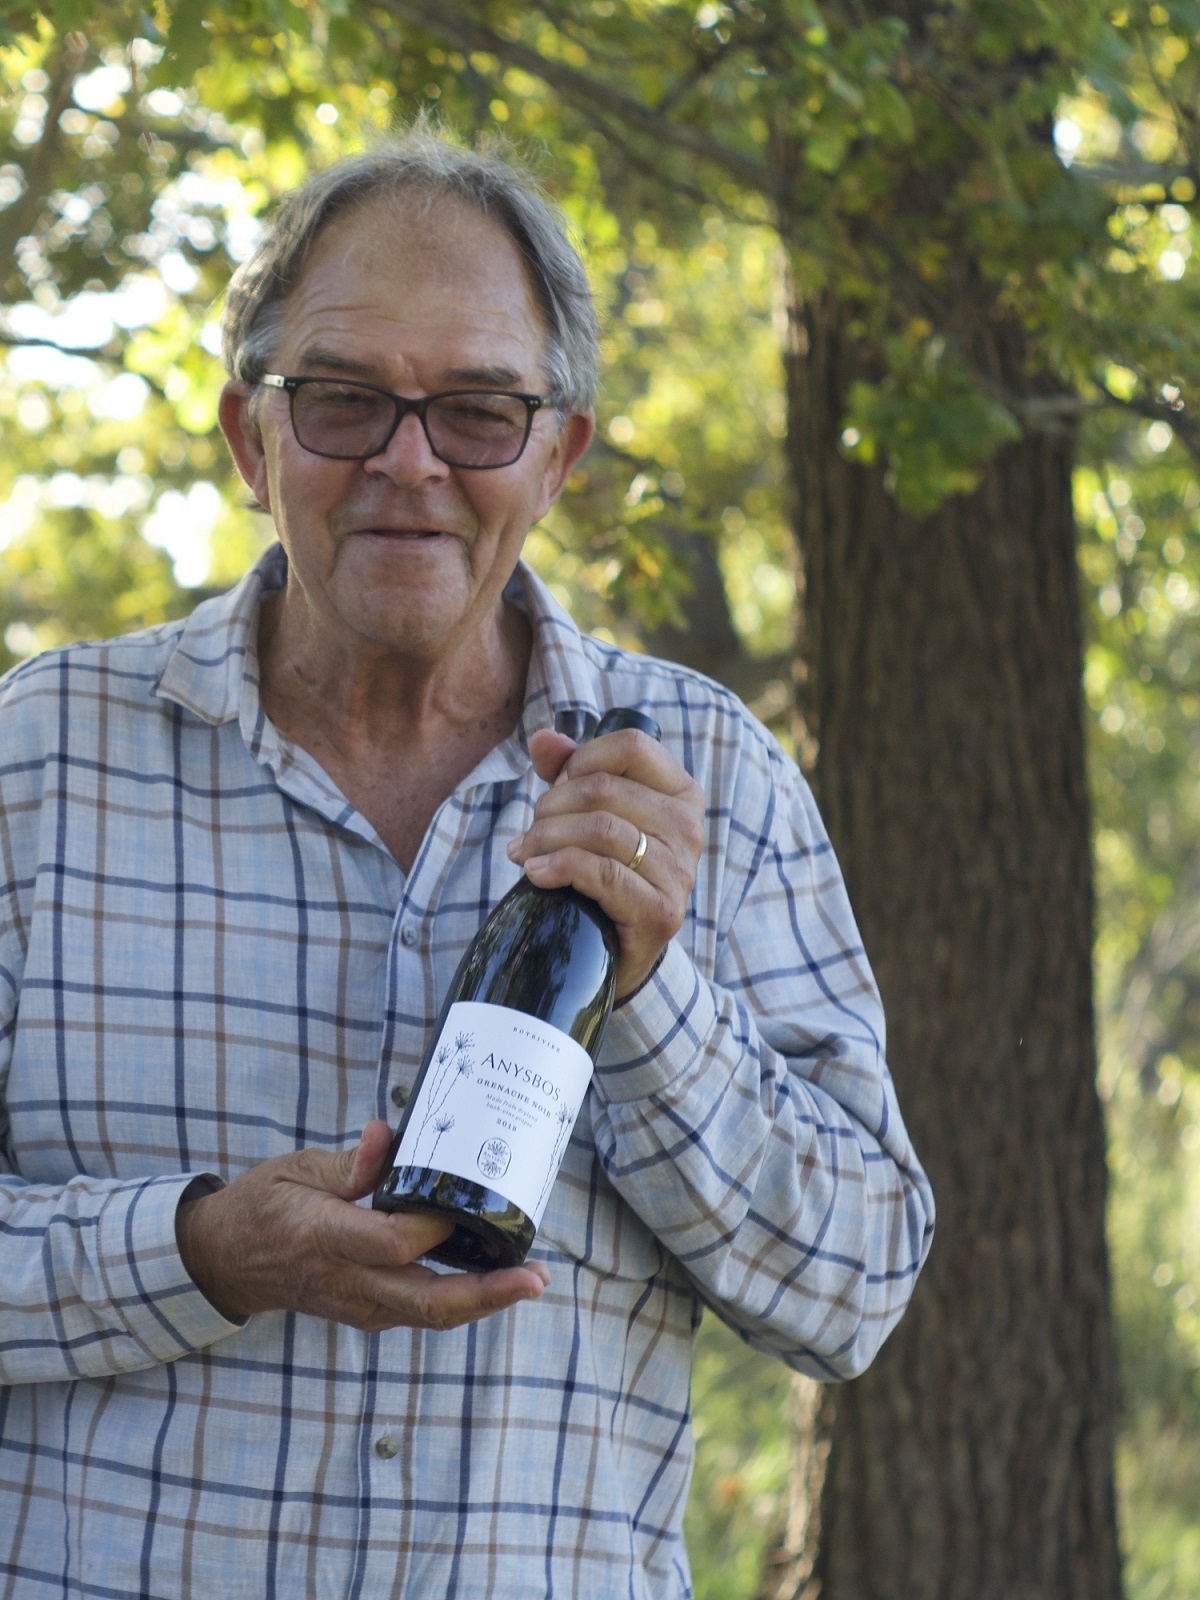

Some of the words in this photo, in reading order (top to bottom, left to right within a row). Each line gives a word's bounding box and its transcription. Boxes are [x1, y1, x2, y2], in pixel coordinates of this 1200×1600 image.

[481, 1052, 561, 1101] ANYSBOS
[476, 1077, 530, 1104] GRENACHE
[532, 1100, 551, 1118] NOIR
[485, 1093, 503, 1104] Made
